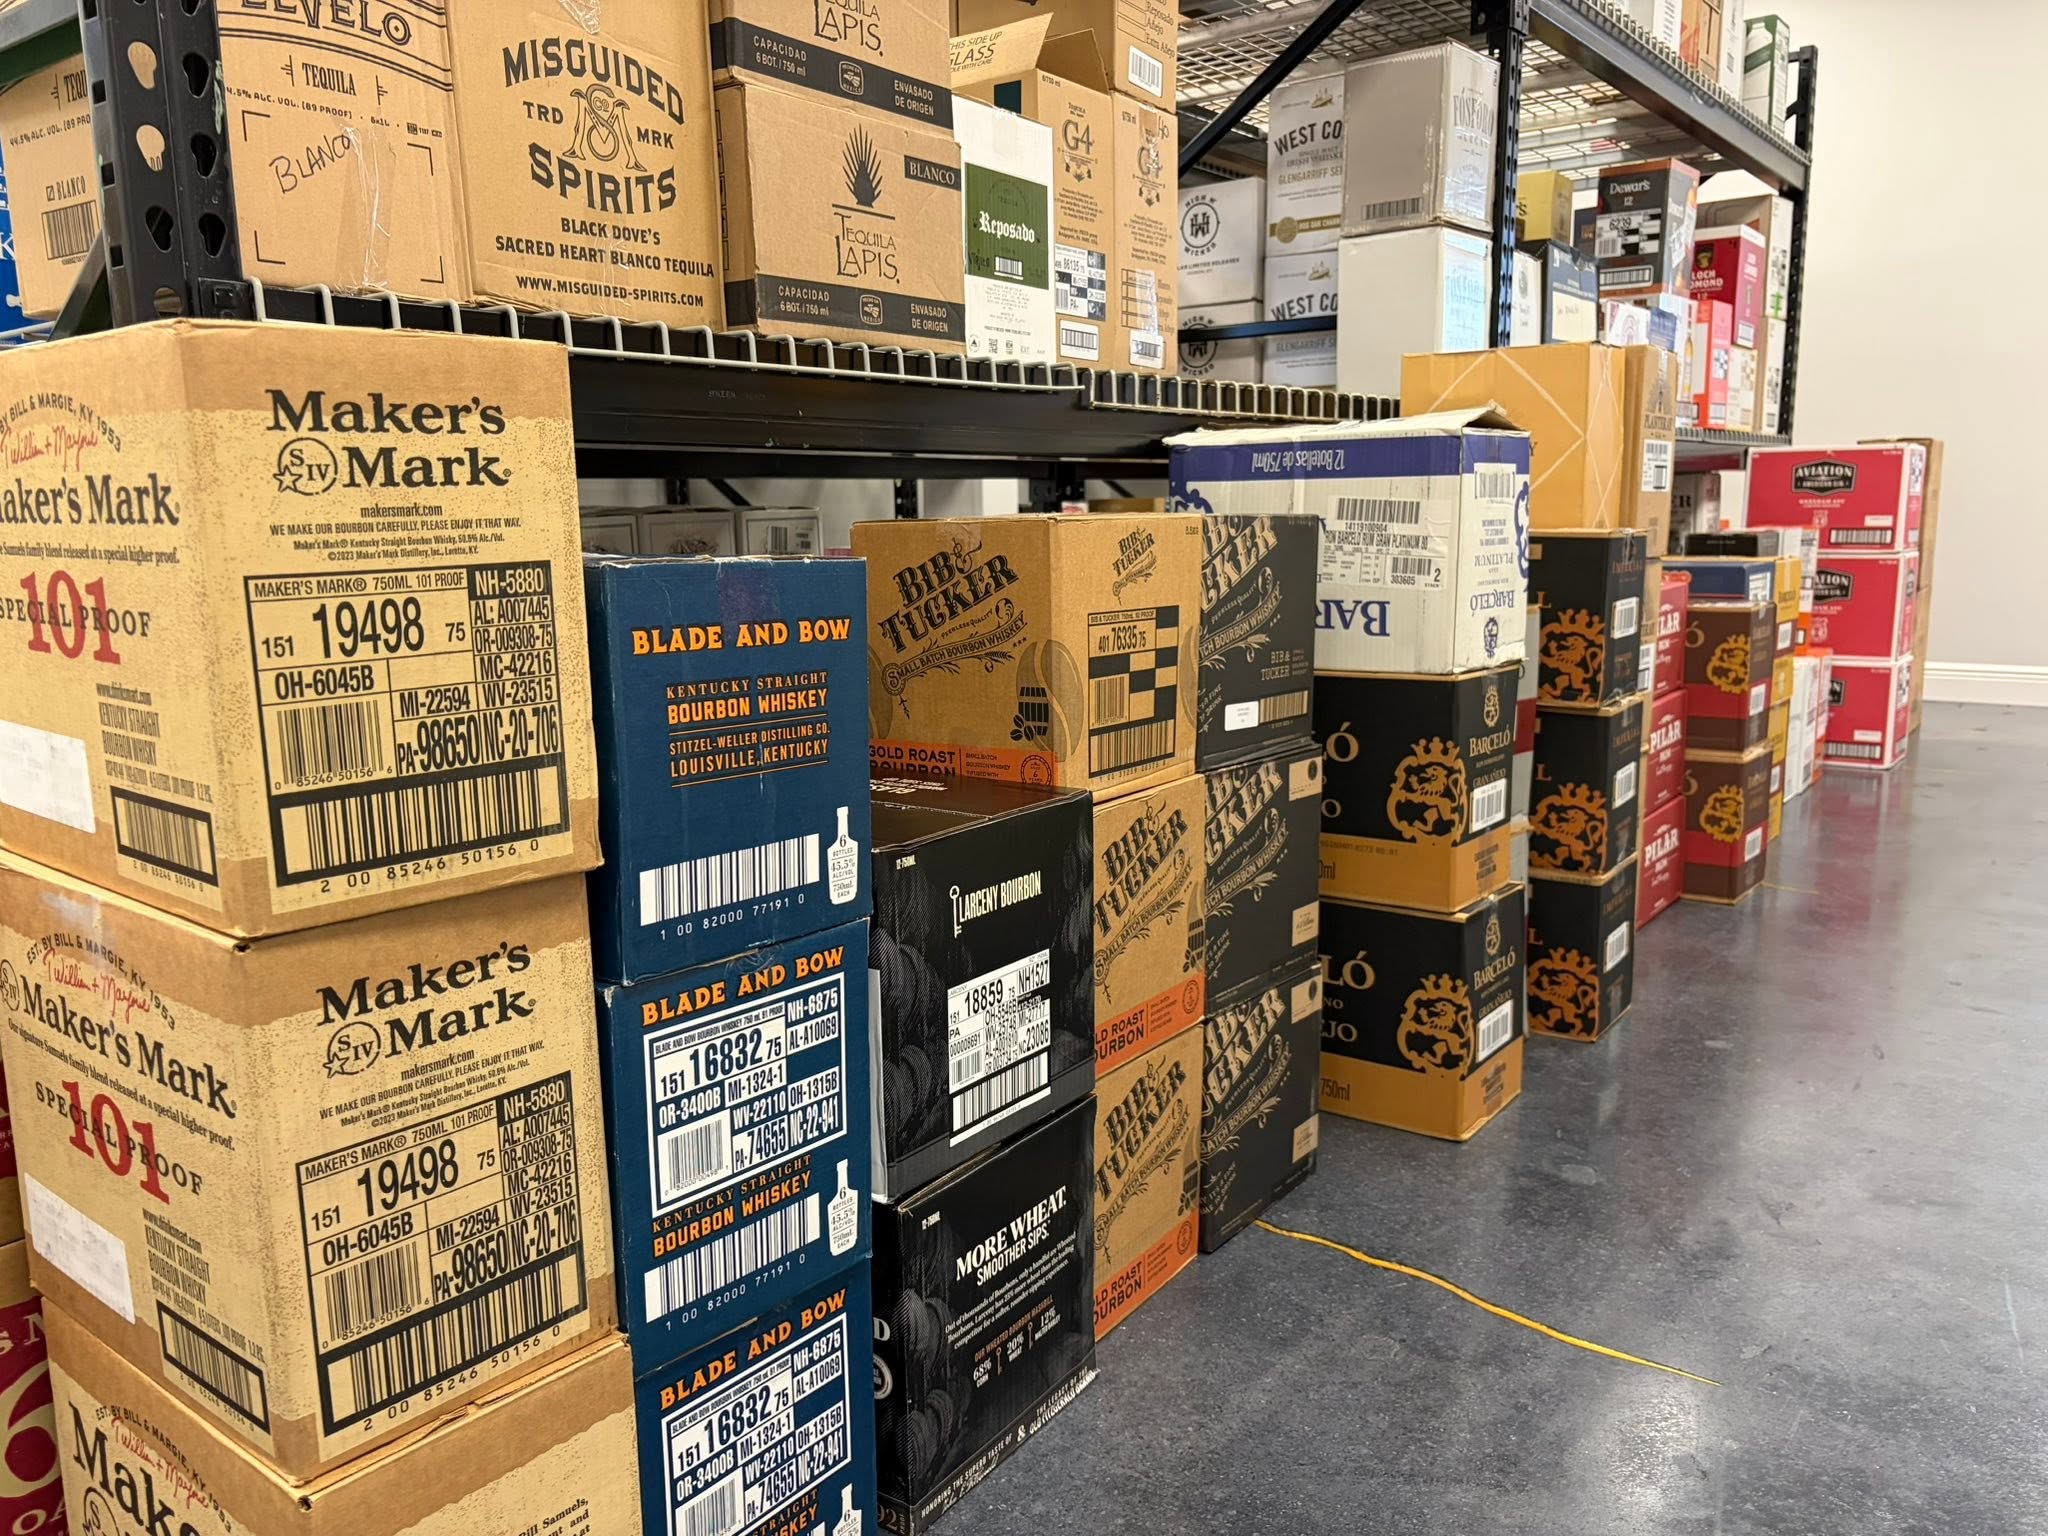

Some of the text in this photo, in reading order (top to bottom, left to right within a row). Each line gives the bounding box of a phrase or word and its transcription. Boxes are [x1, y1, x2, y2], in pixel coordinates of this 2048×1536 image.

[241, 0, 412, 46] VELO
[968, 32, 1002, 47] SIDE UP
[753, 36, 807, 62] CAPACIDAD
[961, 58, 992, 71] WITH CARE
[302, 62, 356, 96] TEQUILA
[502, 37, 685, 126] MISGUIDED
[254, 92, 274, 103] ALC.
[278, 97, 299, 108] VOL.
[894, 80, 934, 116] ENVASADO ORIGEN
[523, 101, 674, 150] TRD MRK
[1063, 119, 1093, 155] G4
[1274, 124, 1316, 156] WEST
[269, 132, 352, 195] BLANCO
[528, 142, 676, 214] SPIRITS
[909, 161, 955, 185] BLANCO
[56, 176, 86, 200] BLANCO
[1610, 180, 1650, 195] Dewar's
[561, 217, 660, 245] BLACK DOVE'S
[834, 213, 896, 250] TEQUILA
[979, 211, 1035, 243] Reposado
[1610, 217, 1631, 231] 6239
[496, 236, 714, 277] SACRED HEART BLANCO TEQUILA
[516, 276, 703, 307] WWW.MISGUIDED-SPIRITS.COM
[1692, 270, 1716, 280] LOCH
[778, 285, 829, 302] CAPACIDAD
[911, 304, 948, 332] ENVASADO ORIGEN
[11, 403, 28, 419] BILL
[265, 389, 506, 434] Maker's
[1796, 465, 1852, 476] AVIATION
[0, 477, 82, 525] aker's
[360, 503, 442, 518] makersmark.com
[288, 524, 313, 534] MAKE
[315, 523, 332, 534] OUR
[335, 522, 373, 533] BOURBON
[421, 520, 448, 530] PLEASE
[450, 519, 473, 529] ENJOY
[255, 580, 313, 597] MAKER'S
[373, 575, 412, 590] 750ML
[417, 573, 432, 587] 101
[435, 571, 465, 586] PROOF
[475, 569, 544, 594] NH-5880
[20, 569, 121, 665] 101
[498, 596, 549, 621] A007445
[878, 555, 1019, 653] TUCKER
[311, 596, 425, 660] 19498
[446, 622, 465, 642] 75
[475, 624, 553, 653] OR-009308-75
[632, 618, 851, 655] BLADE AND BOW
[1112, 627, 1138, 652] 76335
[262, 636, 294, 658] 151
[921, 648, 945, 668] BATCH
[947, 637, 986, 658] BOURBON
[275, 664, 374, 700] OH-6045B
[480, 653, 552, 680] MC-42216
[400, 686, 471, 718] MI-22594
[482, 678, 553, 705] WV-23515
[667, 672, 827, 699] KENTUCKY STRAIGHT
[668, 689, 827, 724] BOURBON WHISKEY
[483, 705, 559, 762] NC-20-706
[669, 725, 813, 755] STITZEL-WELLER DISTILLING
[1469, 724, 1511, 757] BARCELÓ
[1650, 722, 1682, 754] PILAR
[671, 739, 828, 778] LOUISVILLE, KENTUCKY
[909, 747, 956, 764] ROAST
[387, 842, 516, 880] 85246 50156
[1644, 828, 1679, 866] PILAR
[703, 897, 789, 929] 82000 77191
[959, 871, 1042, 922] LARCENY BOURBON
[54, 933, 73, 947] BILL
[149, 990, 176, 1030] 1953
[316, 941, 530, 1026] Maker's
[1019, 960, 1049, 993] NH1527
[1474, 947, 1515, 990] BARCELÓ
[642, 947, 844, 1026] BLADE AND BOW
[965, 979, 1003, 1017] 18859
[20, 974, 131, 1068] Maker's
[788, 989, 838, 1023] NH-6875
[790, 1017, 837, 1051] AL-A10069
[690, 1028, 763, 1086] 16832
[728, 1065, 783, 1103] MI-1324-1
[659, 1088, 721, 1128] OR-3400B
[35, 1081, 202, 1196] SPECIAL PROOF
[61, 1079, 170, 1205] 101
[357, 1138, 460, 1218] 19498
[654, 1171, 811, 1258] BOURBON WHISKEY
[322, 1211, 413, 1265] OH-6045B
[955, 1185, 1066, 1281] MORE WHEAT.
[977, 1240, 1026, 1287] SMOOTHER
[660, 1288, 846, 1410] BLADE AND BOW
[705, 1385, 772, 1454] 16832
